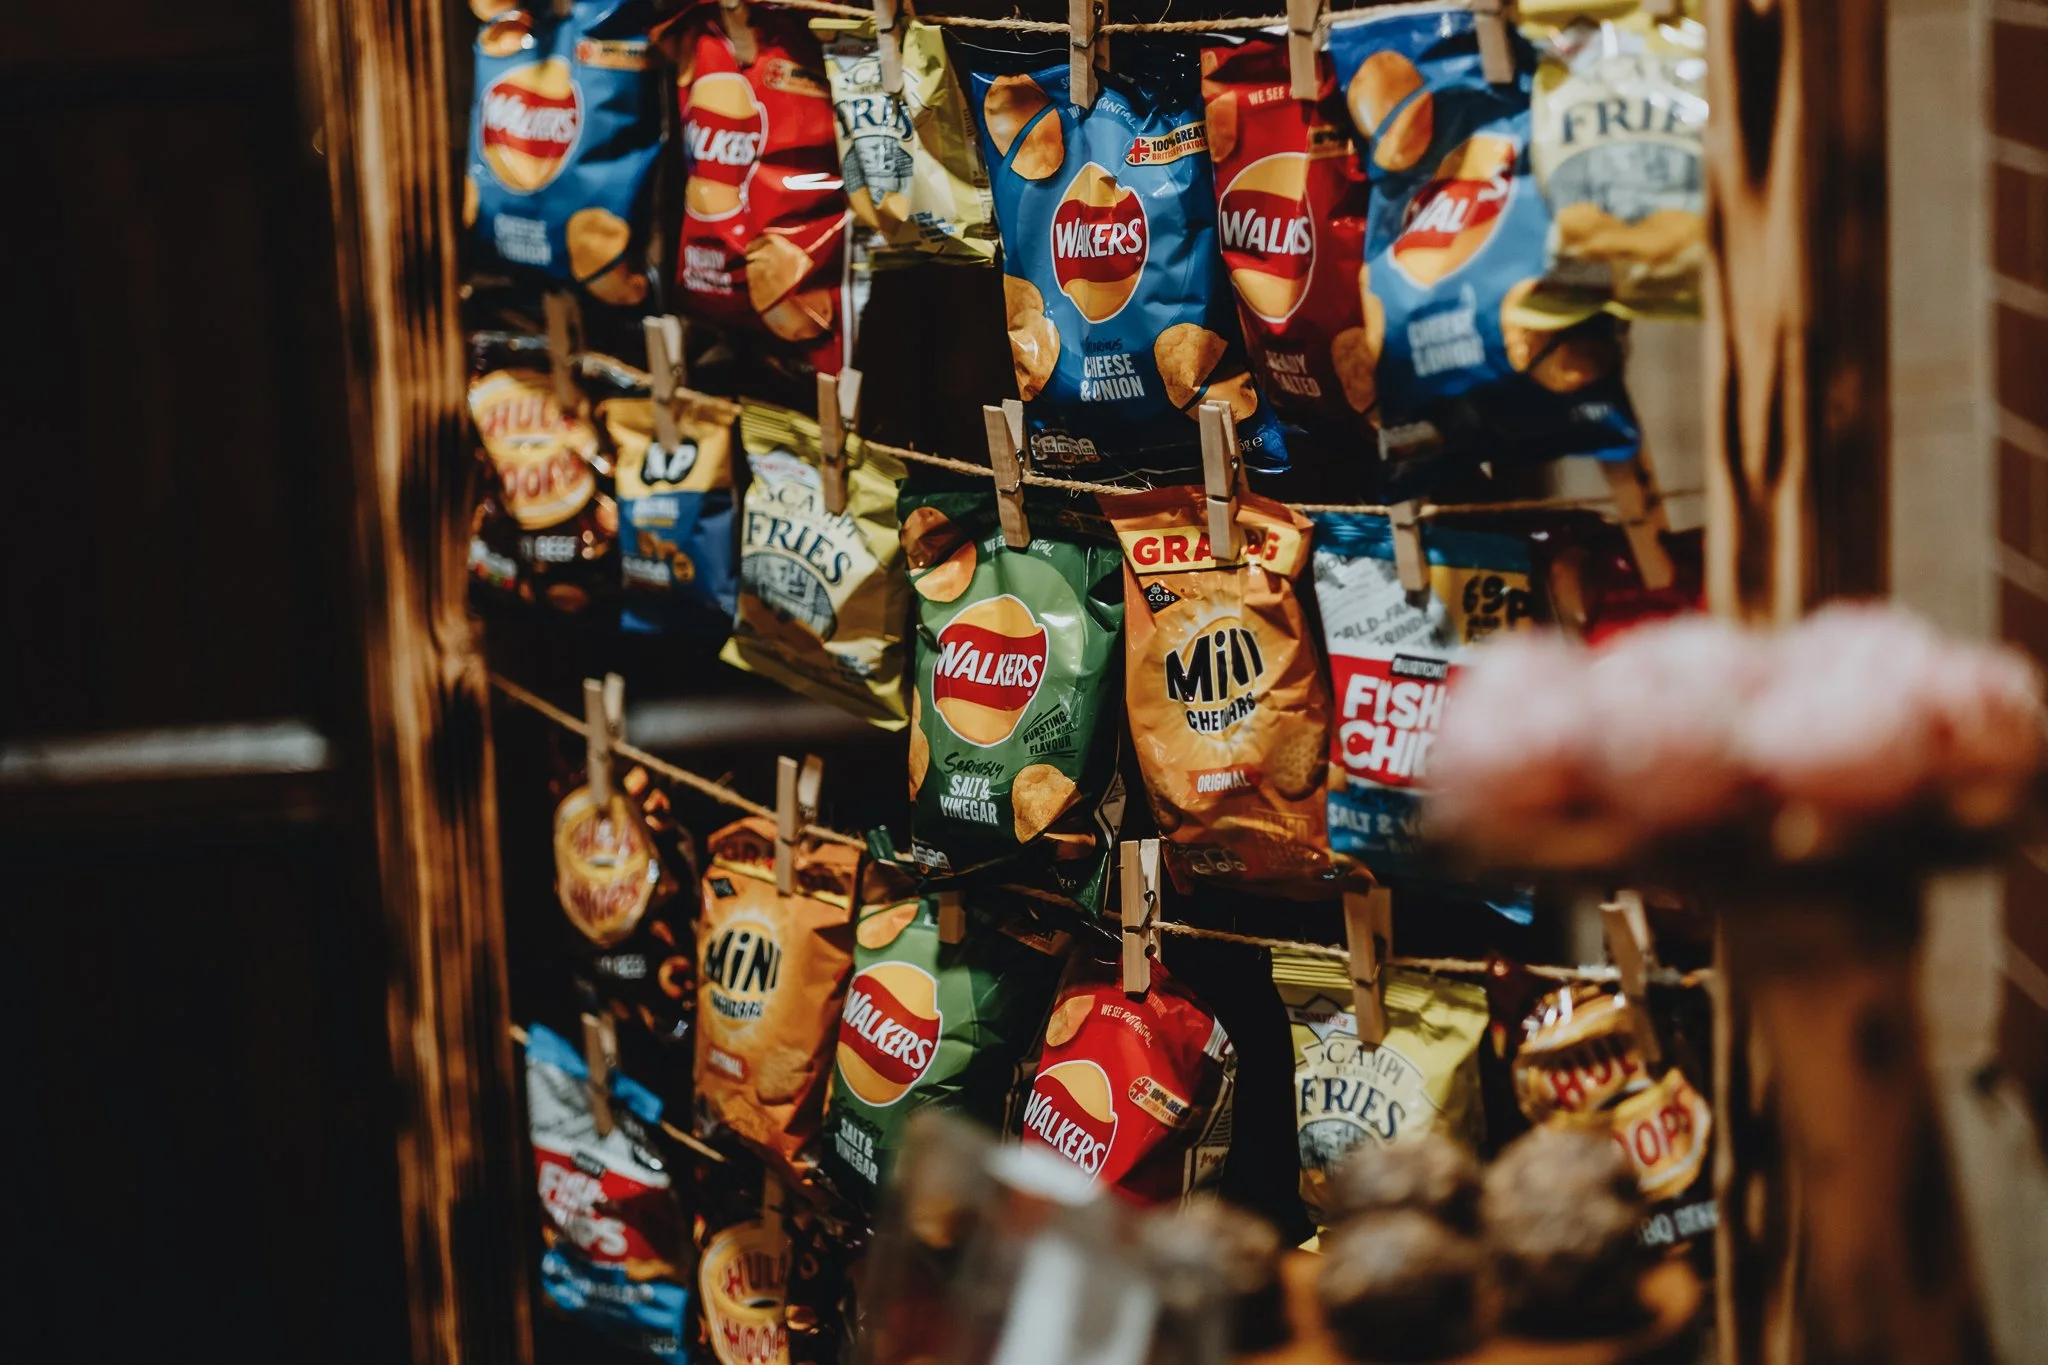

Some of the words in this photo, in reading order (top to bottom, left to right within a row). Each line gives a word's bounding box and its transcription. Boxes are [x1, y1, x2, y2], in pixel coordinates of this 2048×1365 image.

[1249, 89, 1265, 105] WE
[1266, 86, 1284, 101] SEE
[1084, 353, 1136, 378] CHEESE
[745, 509, 852, 586] FRIES
[1133, 533, 1217, 566] GRA
[936, 640, 1043, 688] WALKERS
[1023, 710, 1067, 745] BURSTING
[1029, 734, 1071, 755] FLAVOUR
[1197, 769, 1251, 793] ORIGINAL
[940, 795, 999, 826] VINEGAR
[1327, 802, 1371, 835] SALT
[1101, 1003, 1114, 1016] WE
[842, 987, 933, 1070] WALKERS
[1300, 1075, 1407, 1140] FRIES
[1023, 1089, 1106, 1175] WALKERS
